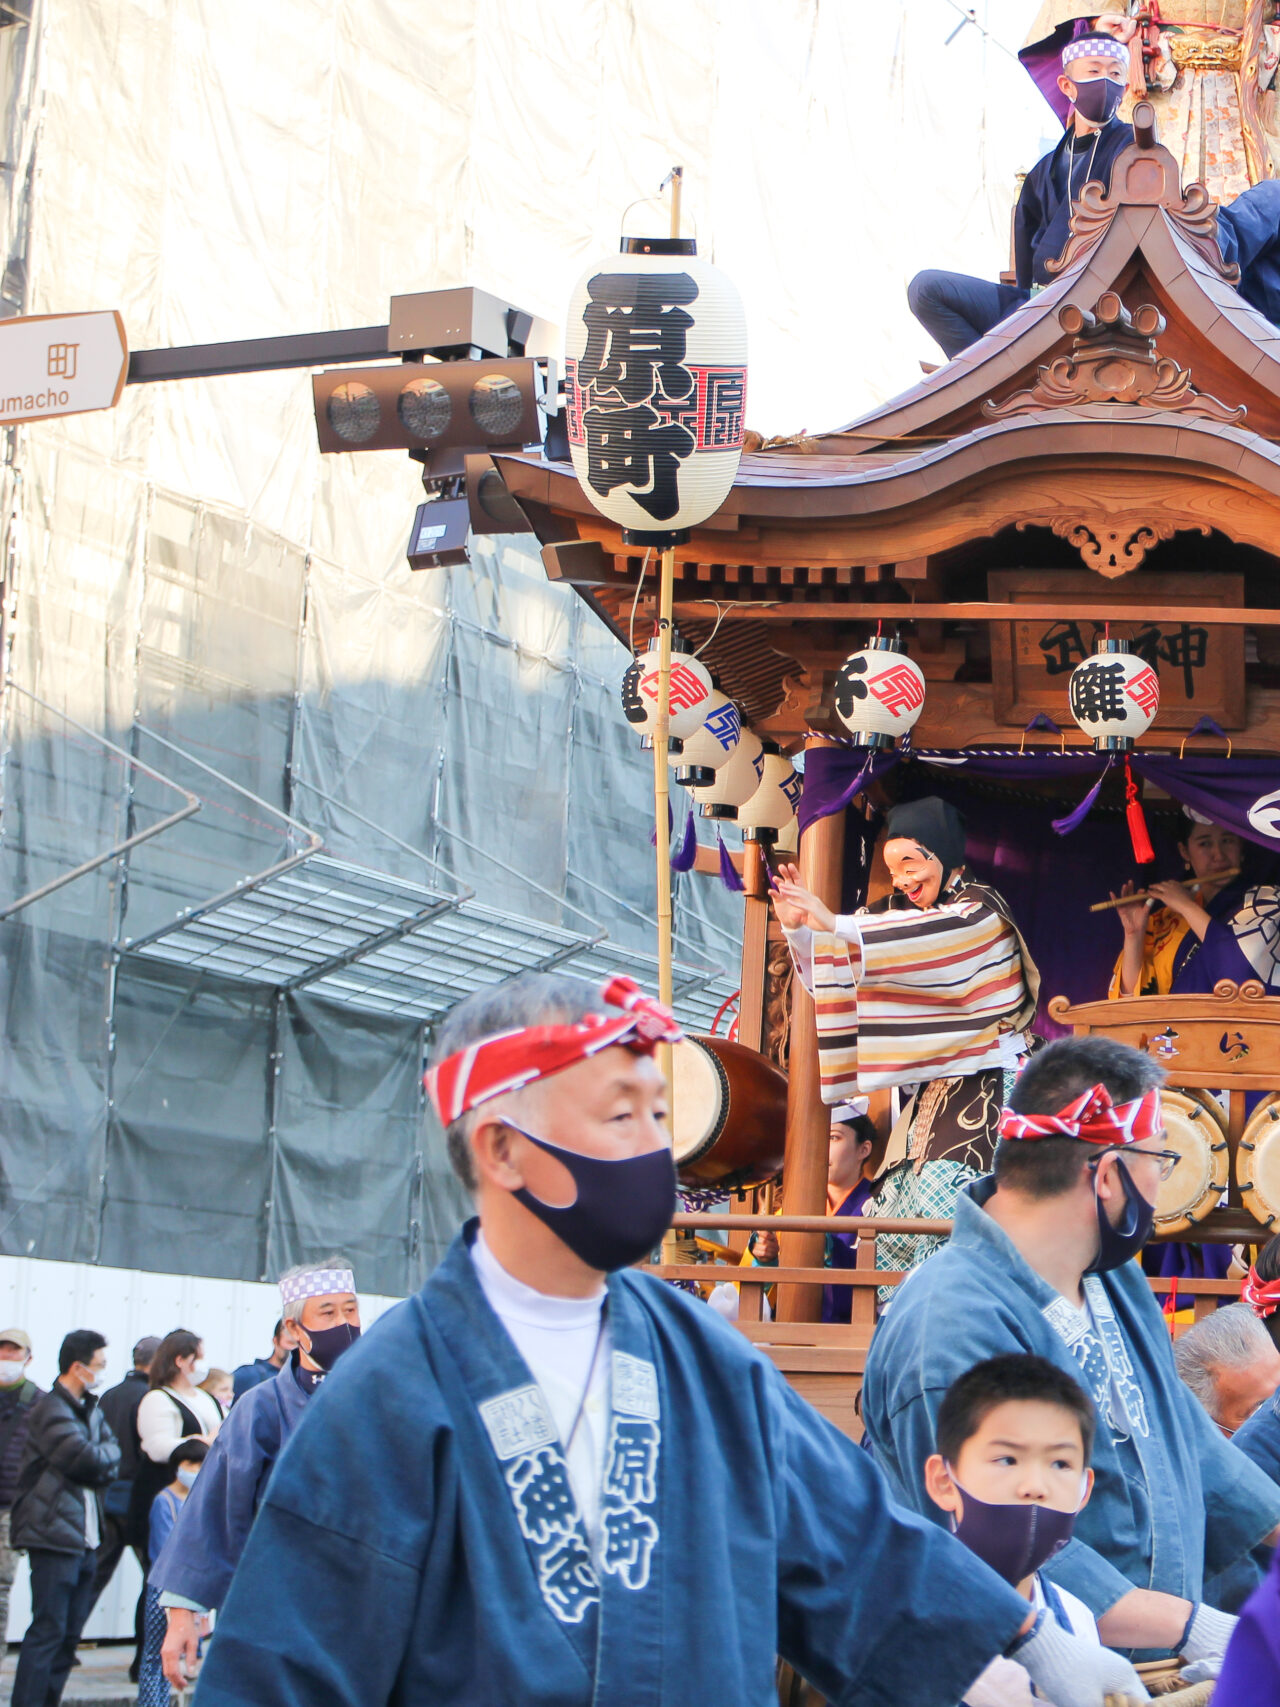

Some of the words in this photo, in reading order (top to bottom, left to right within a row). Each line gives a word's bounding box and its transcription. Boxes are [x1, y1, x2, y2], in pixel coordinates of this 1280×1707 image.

[48, 343, 80, 379] 町
[577, 272, 699, 521] 原町
[602, 1415, 661, 1589] 原町
